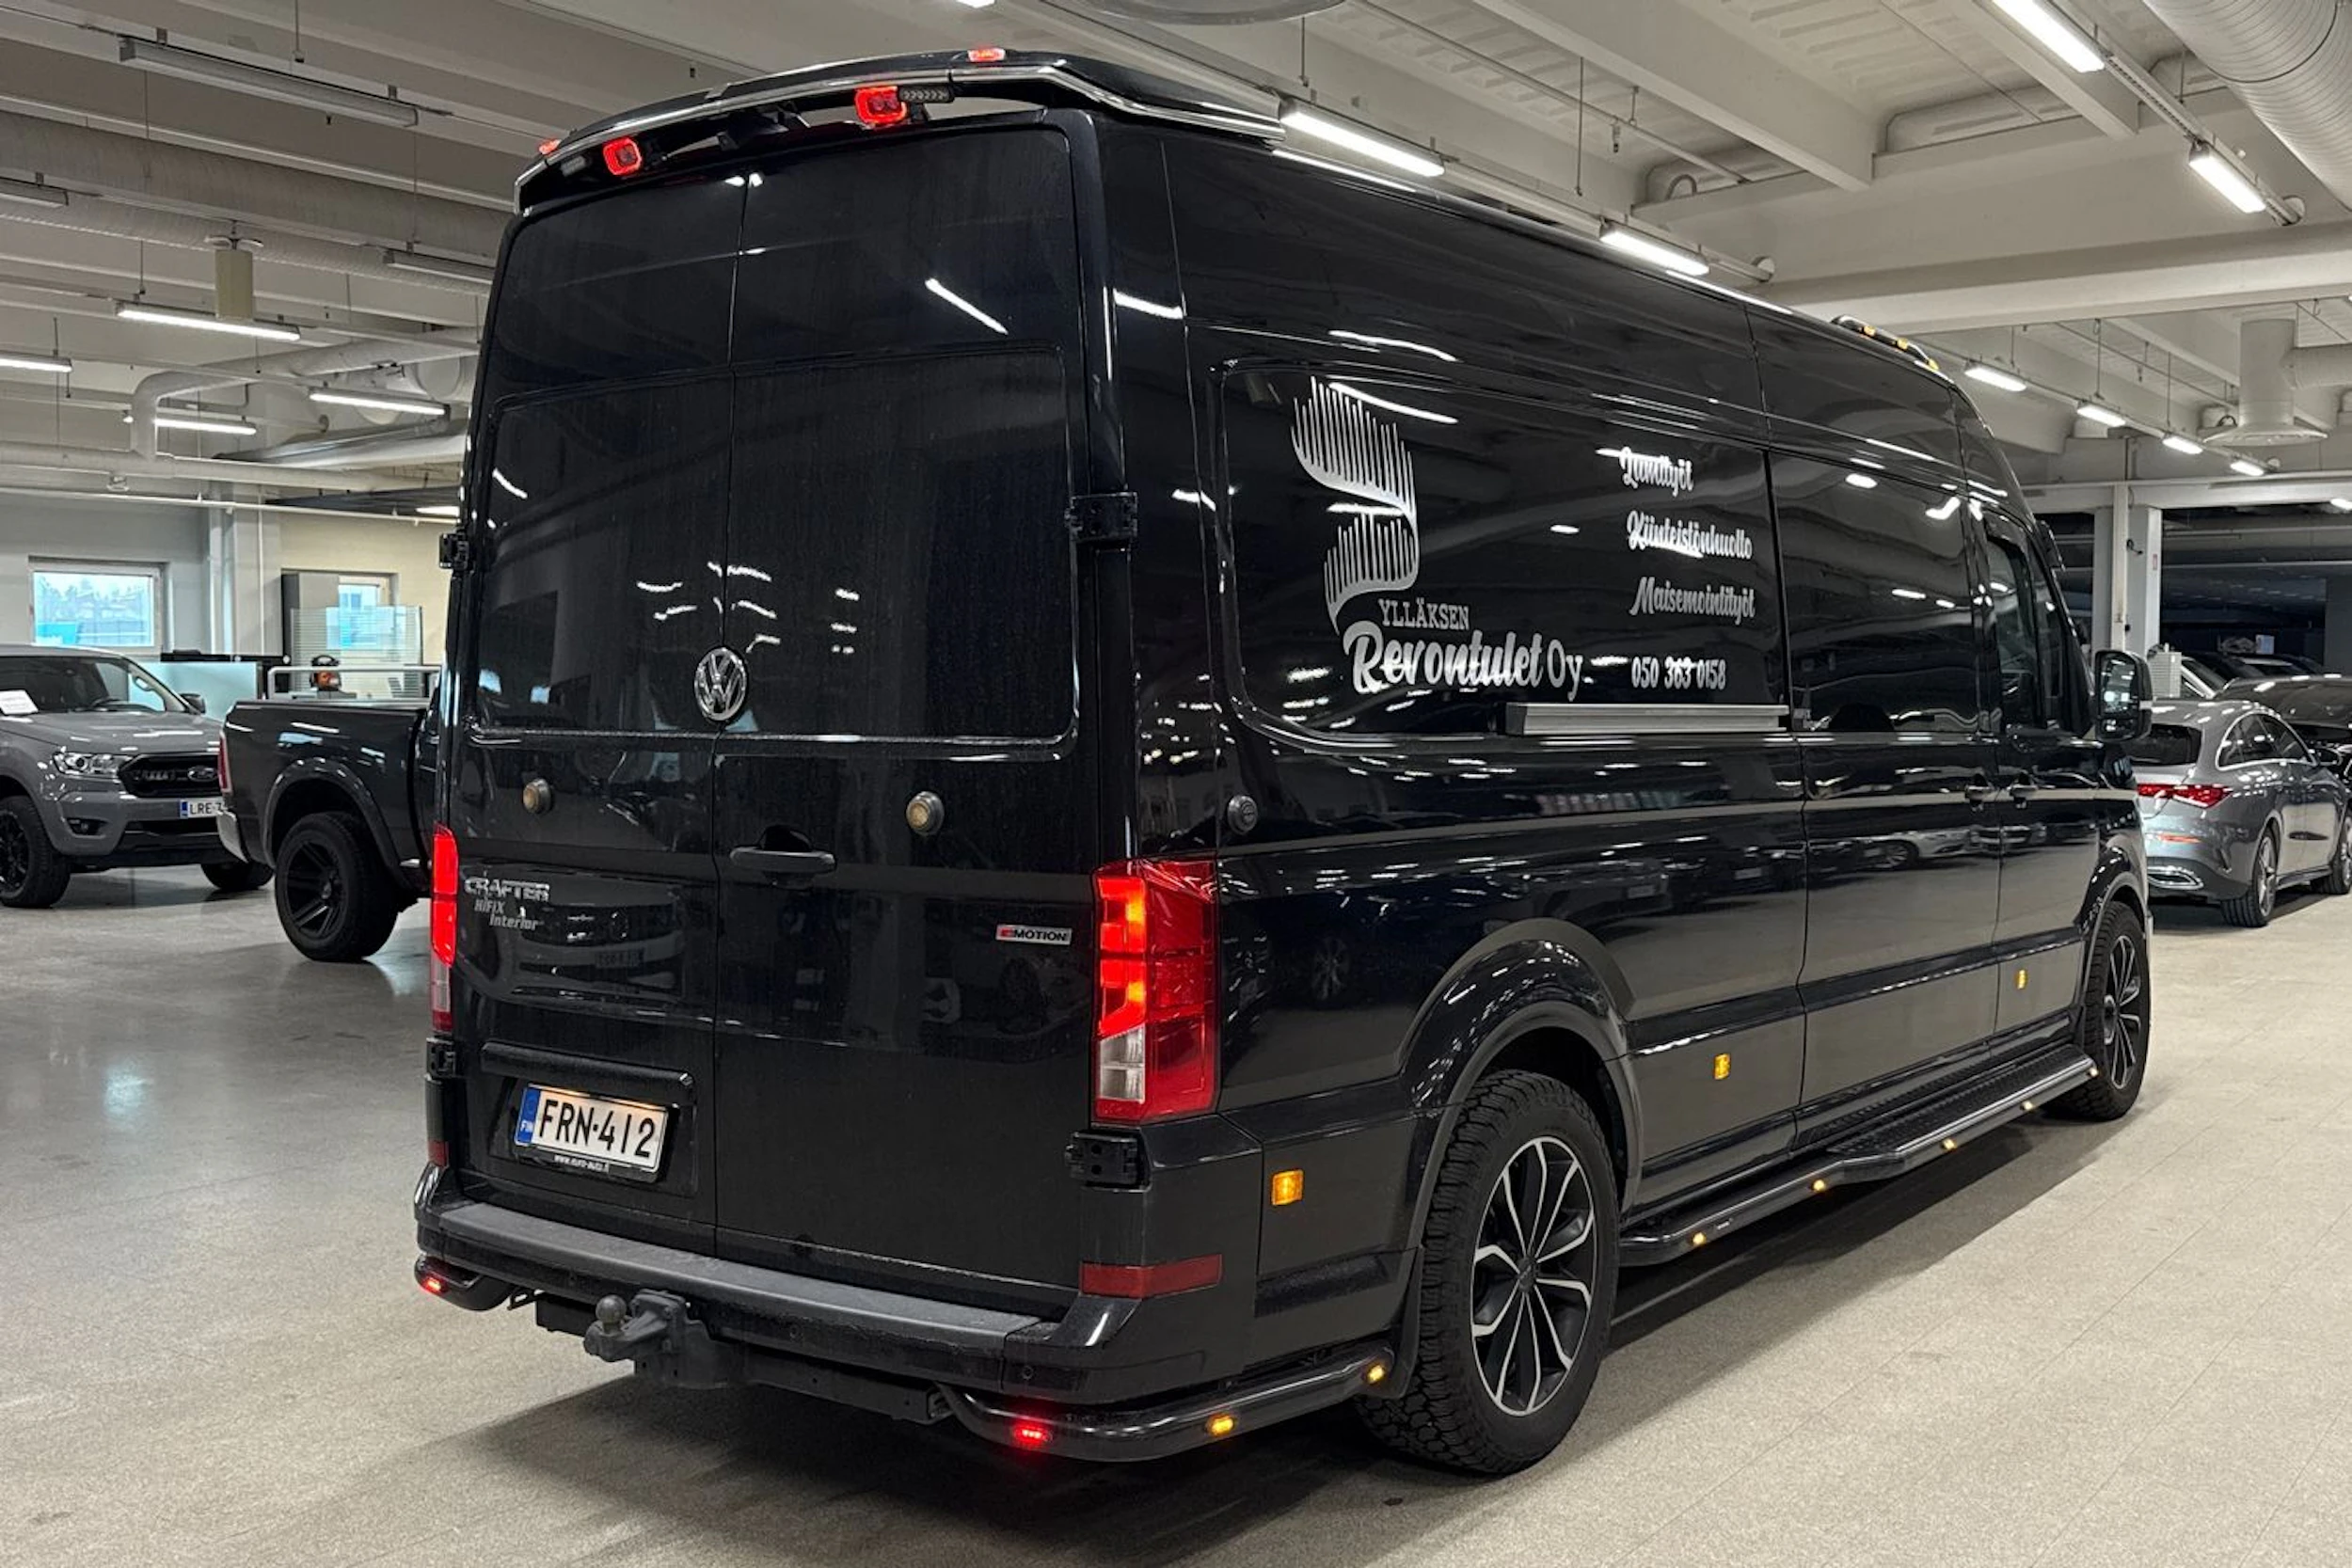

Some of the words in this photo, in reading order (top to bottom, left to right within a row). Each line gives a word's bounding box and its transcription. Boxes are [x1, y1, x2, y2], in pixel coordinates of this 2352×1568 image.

[1627, 510, 1753, 560] Kiinteistönhuolto
[1377, 597, 1470, 631] YLLÄKSEN
[1629, 577, 1756, 626] Maisemointityöt
[1343, 620, 1544, 694] Revontulet
[1548, 639, 1583, 702] Oy
[1631, 657, 1660, 689] 050
[1664, 657, 1692, 689] 363
[1696, 659, 1726, 690] 0158
[465, 877, 550, 902] CRAFTER
[489, 913, 539, 930] Interior
[539, 1099, 656, 1158] FRN-412
